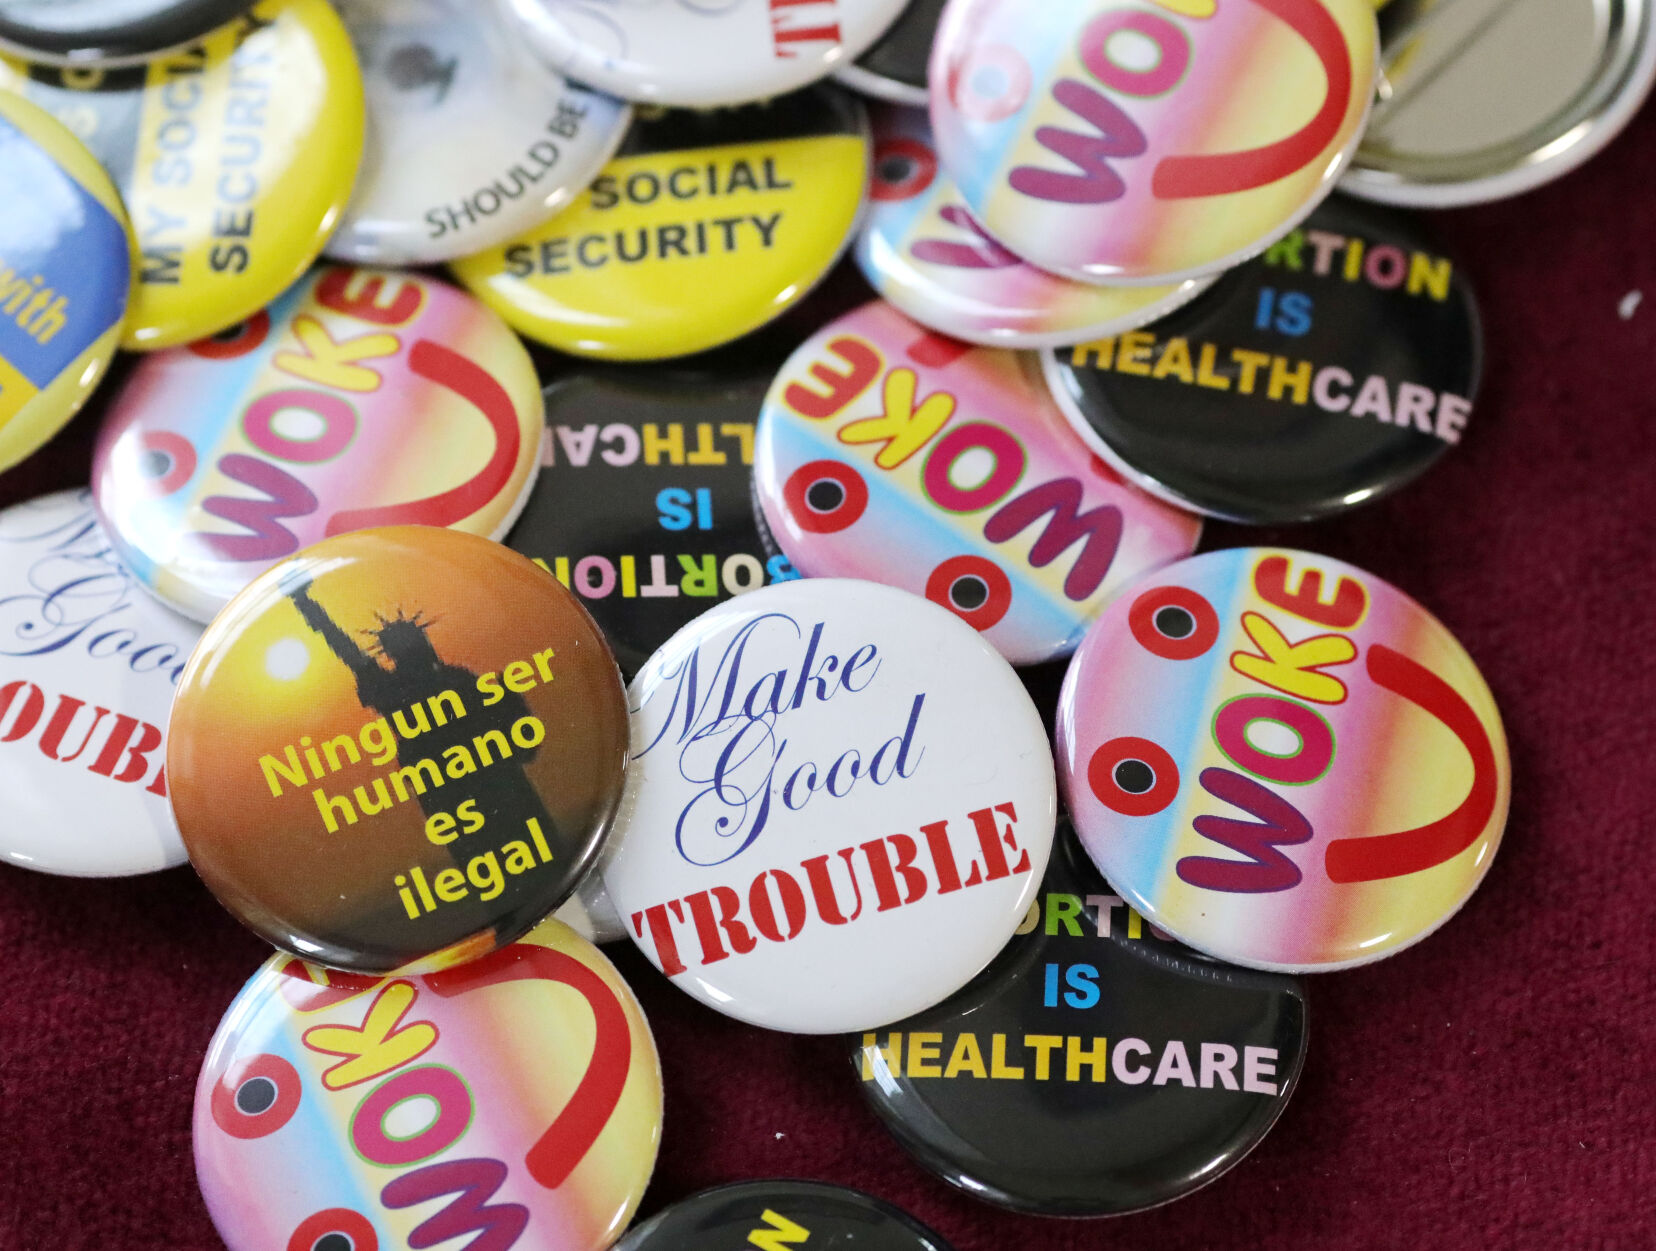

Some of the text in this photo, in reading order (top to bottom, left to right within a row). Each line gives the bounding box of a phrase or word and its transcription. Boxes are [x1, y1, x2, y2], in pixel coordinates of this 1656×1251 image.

[1008, 0, 1218, 204] WO
[425, 102, 588, 239] SHOULD BE
[590, 157, 793, 210] SOCIAL
[503, 212, 784, 279] SECURITY
[1263, 230, 1453, 300] RTION
[1254, 287, 1314, 336] IS
[187, 265, 430, 562] WOKE
[1071, 330, 1472, 444] HEALTHCARE
[541, 423, 757, 467] LTHCA
[782, 334, 1124, 602] WOKE
[655, 487, 713, 531] IS
[258, 647, 555, 798] Ningun ser
[631, 613, 883, 760] Make
[1176, 554, 1370, 893] WOKE
[312, 715, 546, 834] humano
[424, 798, 486, 846] es
[675, 692, 927, 867] Good
[394, 816, 554, 920] ilegal
[632, 801, 1032, 978] TROUBLE
[1044, 963, 1101, 1009] IS
[861, 1032, 1280, 1097] HEALTHCARE
